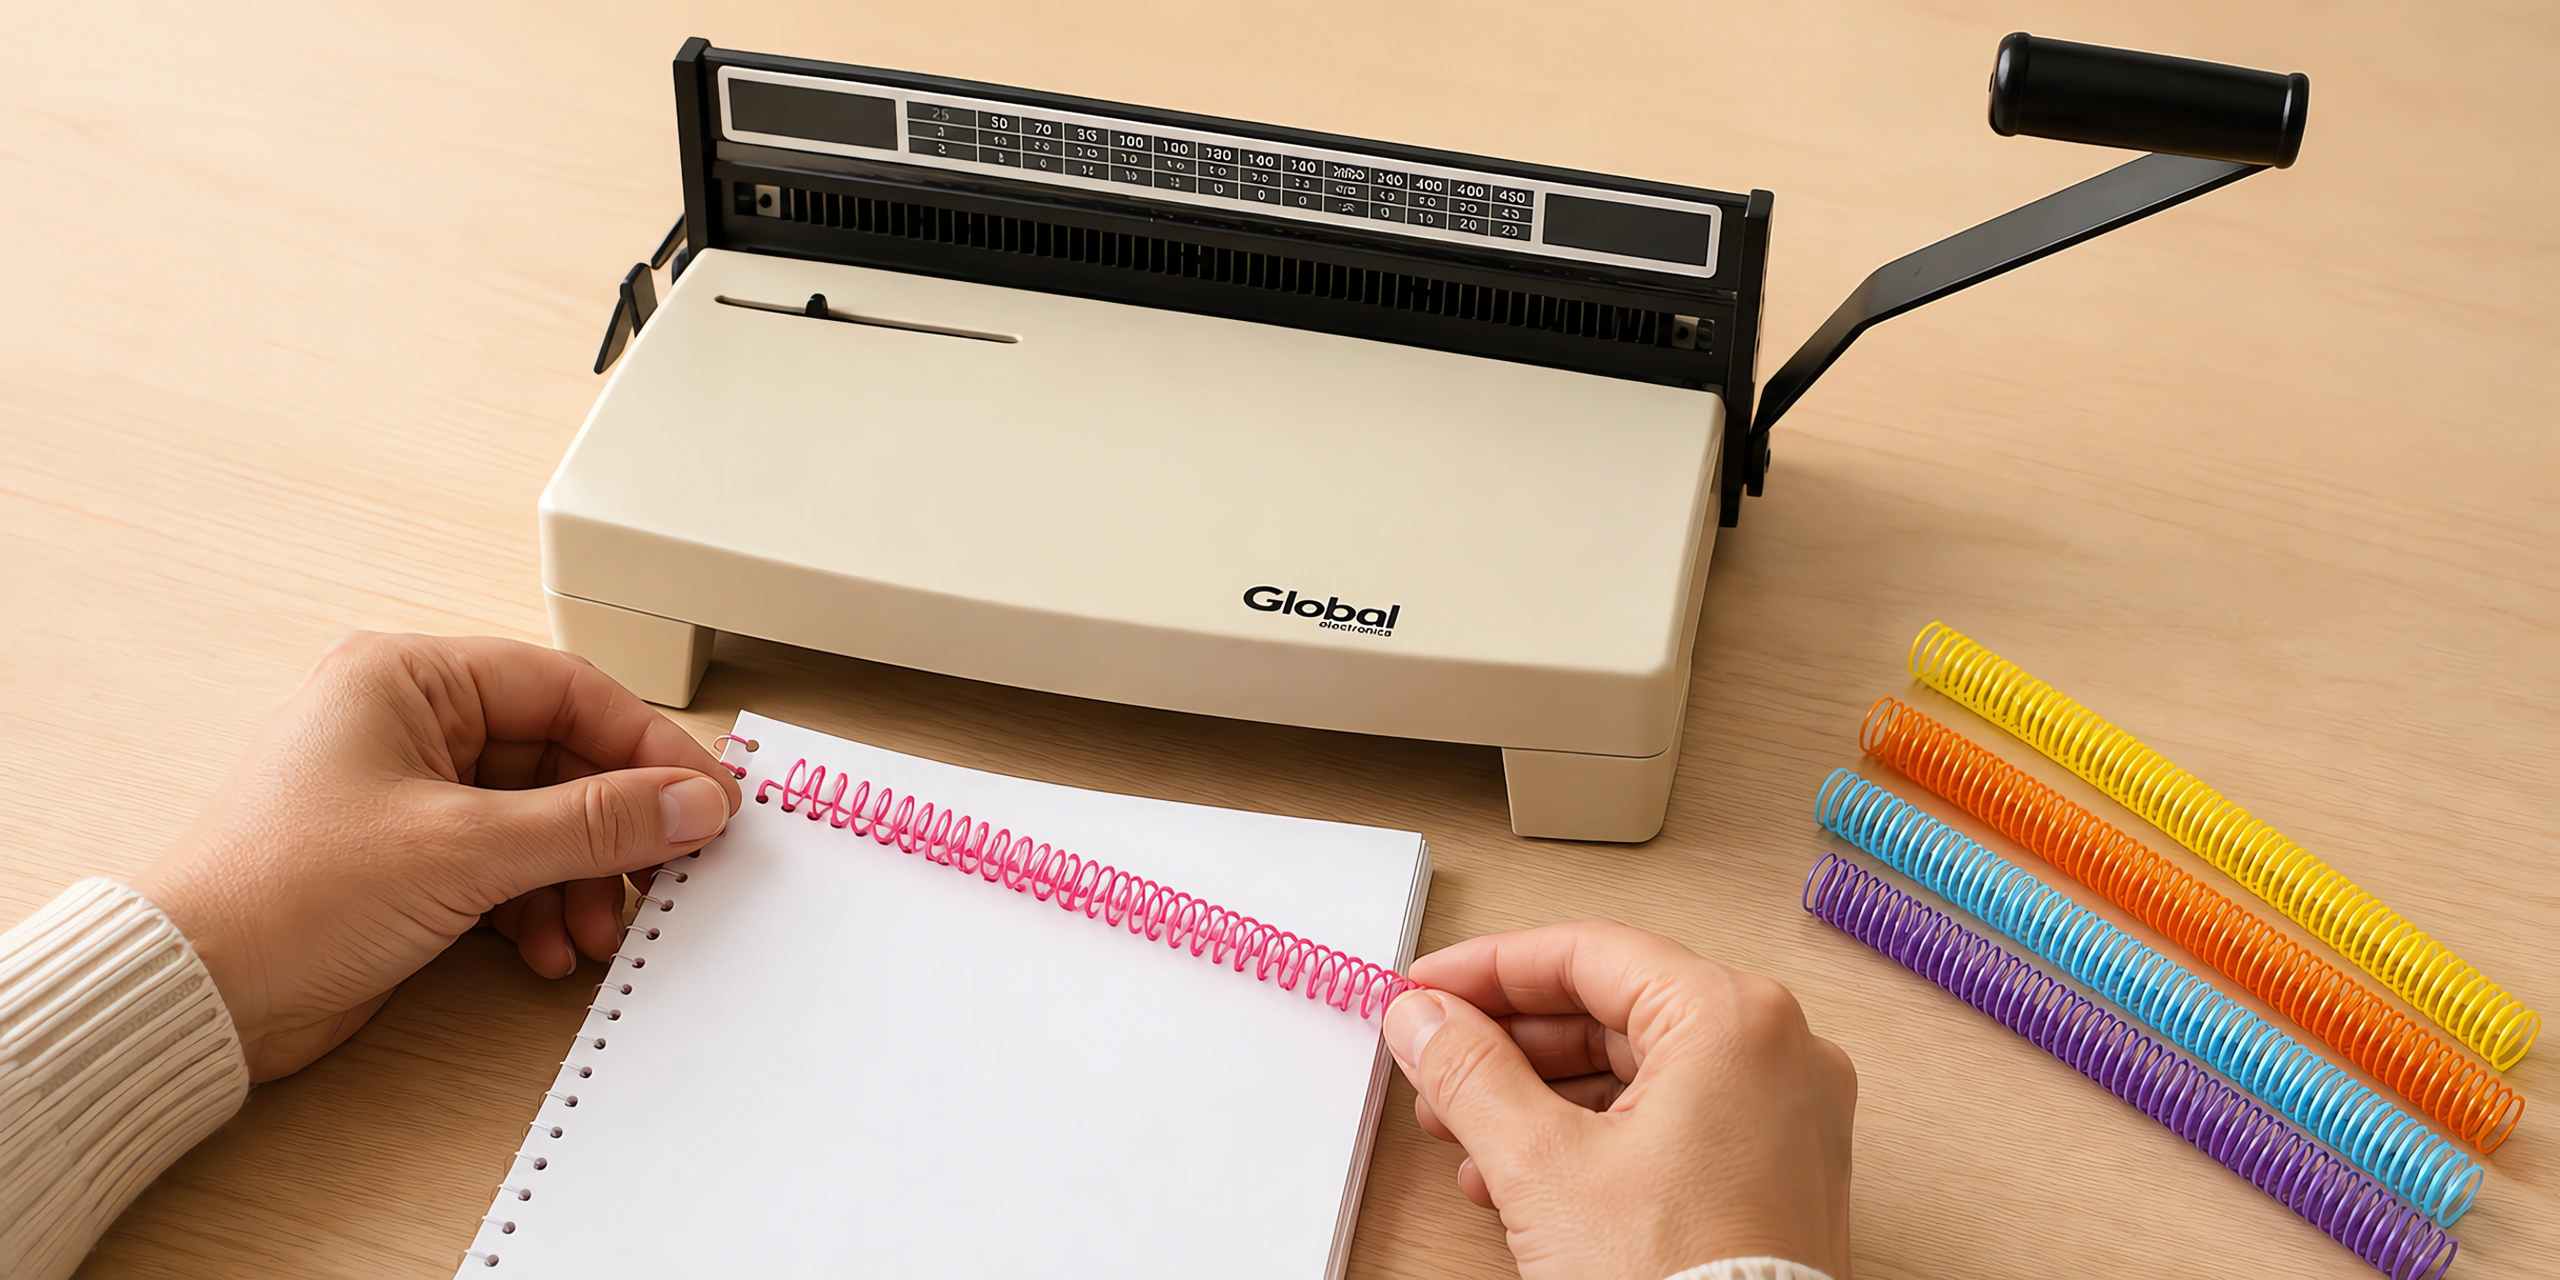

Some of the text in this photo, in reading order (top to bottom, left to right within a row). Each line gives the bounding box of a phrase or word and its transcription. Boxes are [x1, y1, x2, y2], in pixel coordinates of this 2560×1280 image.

[1034, 123, 1052, 135] 70
[1119, 135, 1144, 148] 100
[1415, 178, 1443, 192] 400
[1457, 184, 1484, 197] 400
[1499, 190, 1526, 204] 450
[1459, 218, 1477, 231] 20
[1243, 586, 1400, 629] Global
